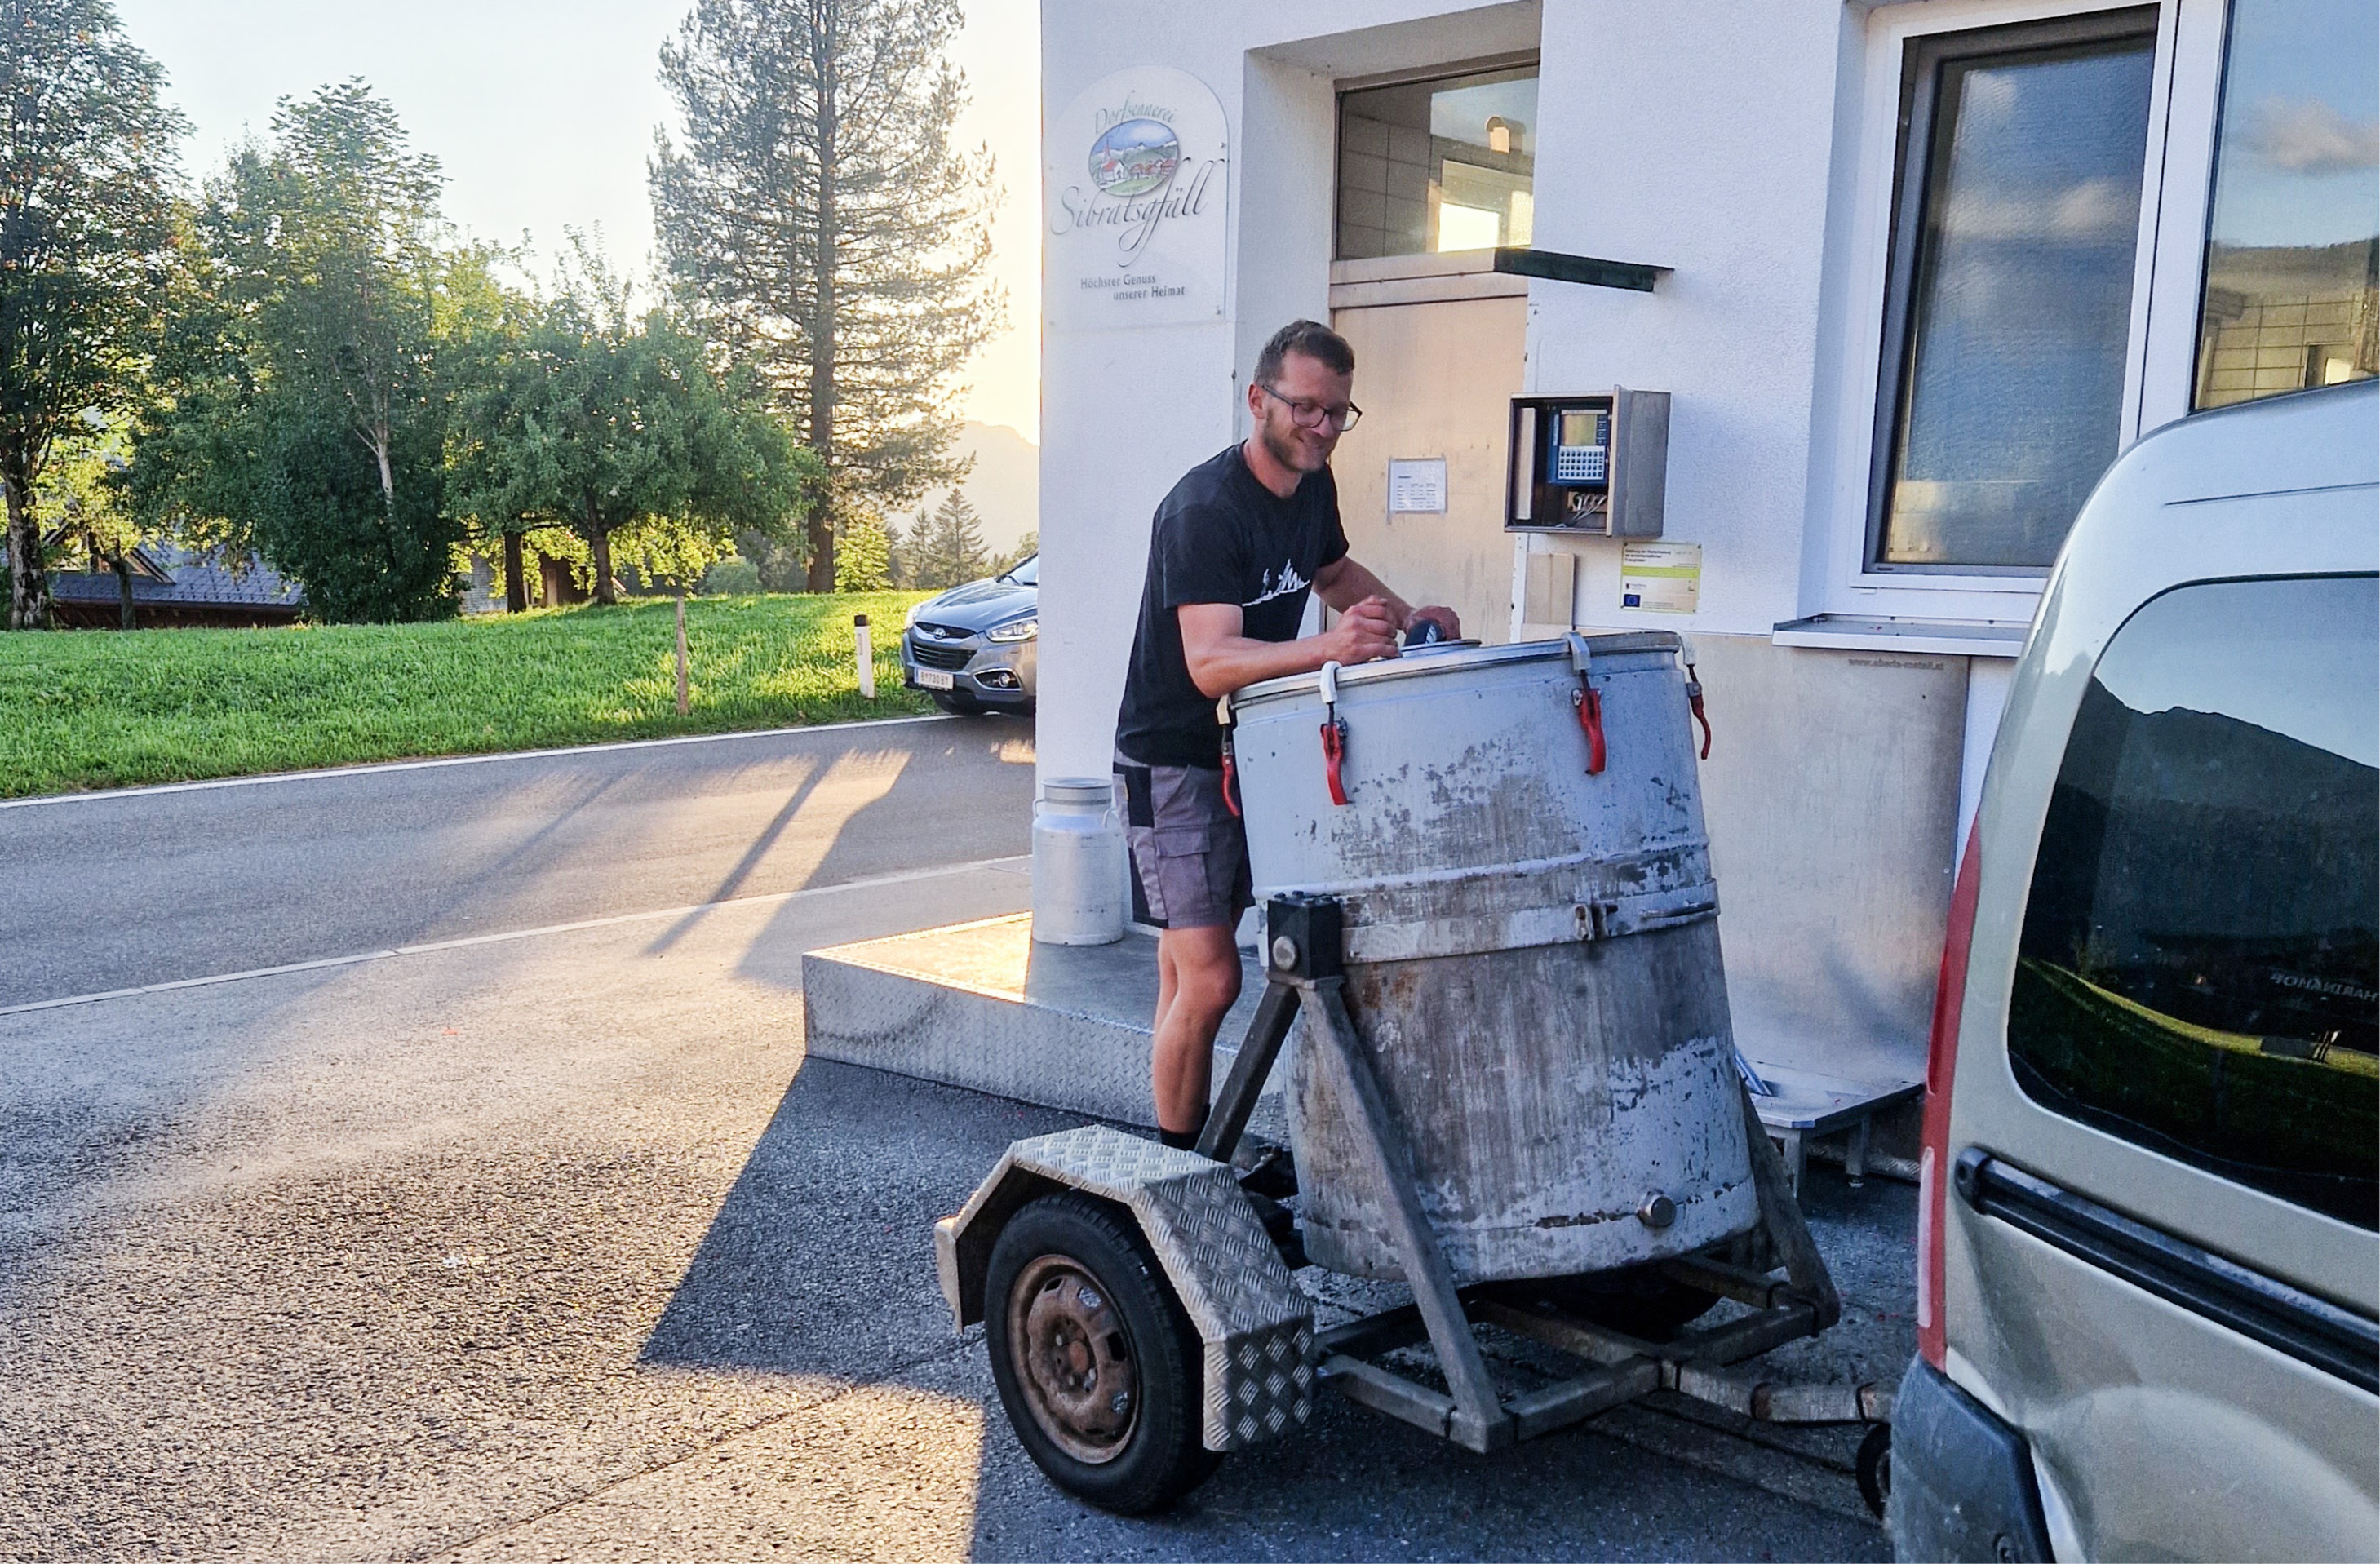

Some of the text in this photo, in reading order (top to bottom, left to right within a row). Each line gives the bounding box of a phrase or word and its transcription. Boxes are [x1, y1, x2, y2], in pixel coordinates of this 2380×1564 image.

[1095, 89, 1177, 134] Dorfsennerei
[1050, 157, 1225, 268] Sibratsgfäll
[1080, 273, 1156, 290] Höchster Genuss
[1113, 286, 1185, 300] unserer Heimat
